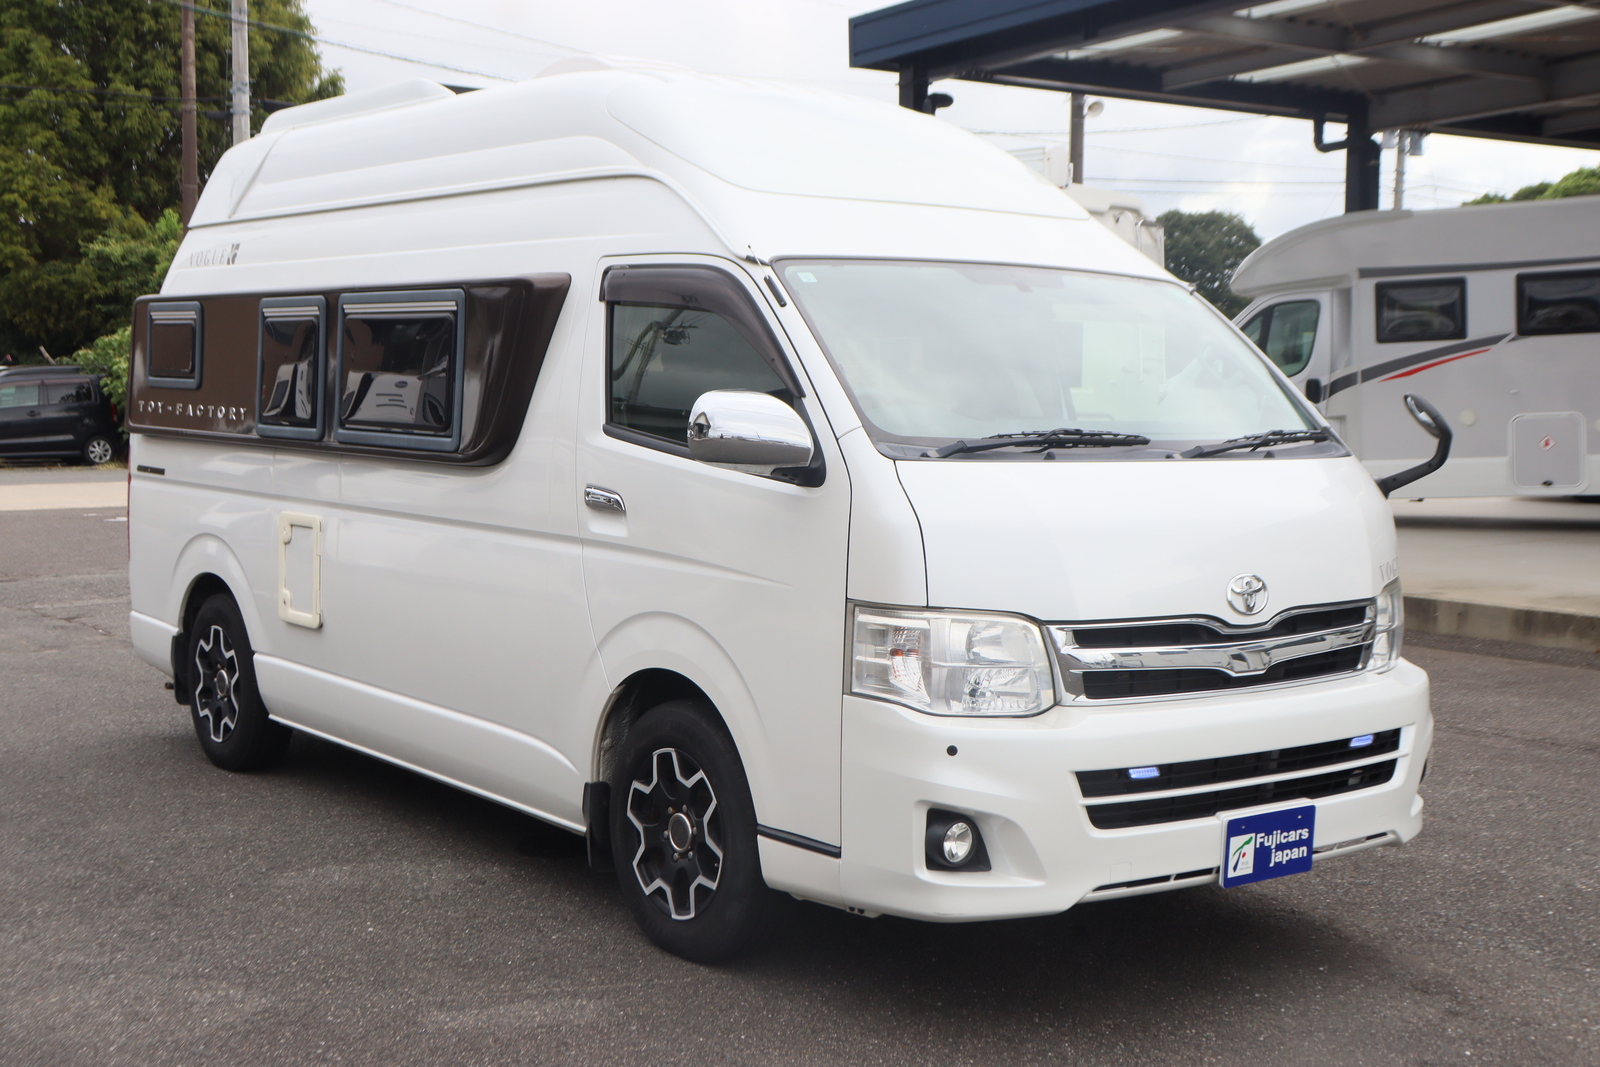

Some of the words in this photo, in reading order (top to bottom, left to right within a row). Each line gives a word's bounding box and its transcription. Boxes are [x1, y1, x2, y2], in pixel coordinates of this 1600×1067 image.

[138, 400, 247, 420] TOY-FACTORY
[1256, 828, 1309, 848] Fujicars
[1269, 846, 1307, 867] japan
